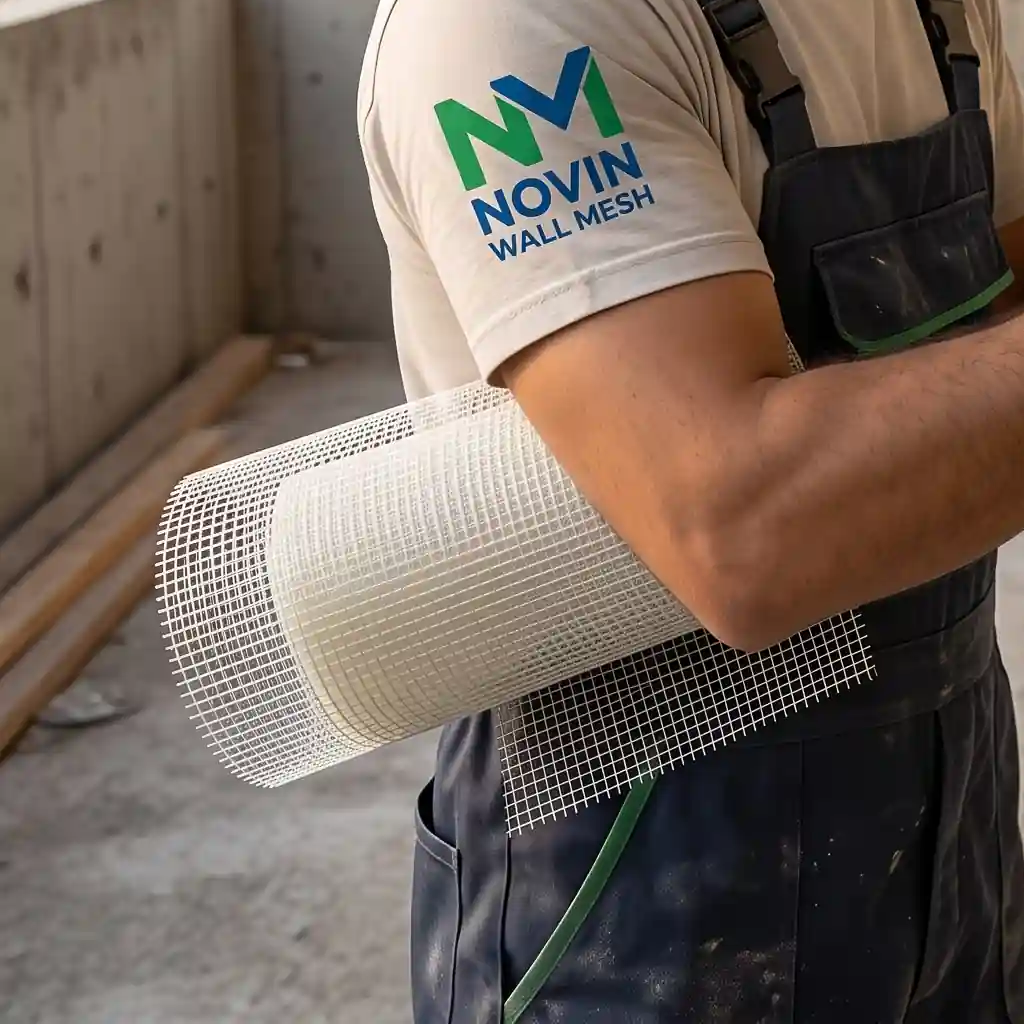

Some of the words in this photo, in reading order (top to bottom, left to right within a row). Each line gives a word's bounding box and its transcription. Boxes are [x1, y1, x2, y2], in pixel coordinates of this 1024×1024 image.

[470, 141, 644, 236] NOVIN
[487, 218, 573, 262] WALL
[573, 183, 656, 231] MESH
